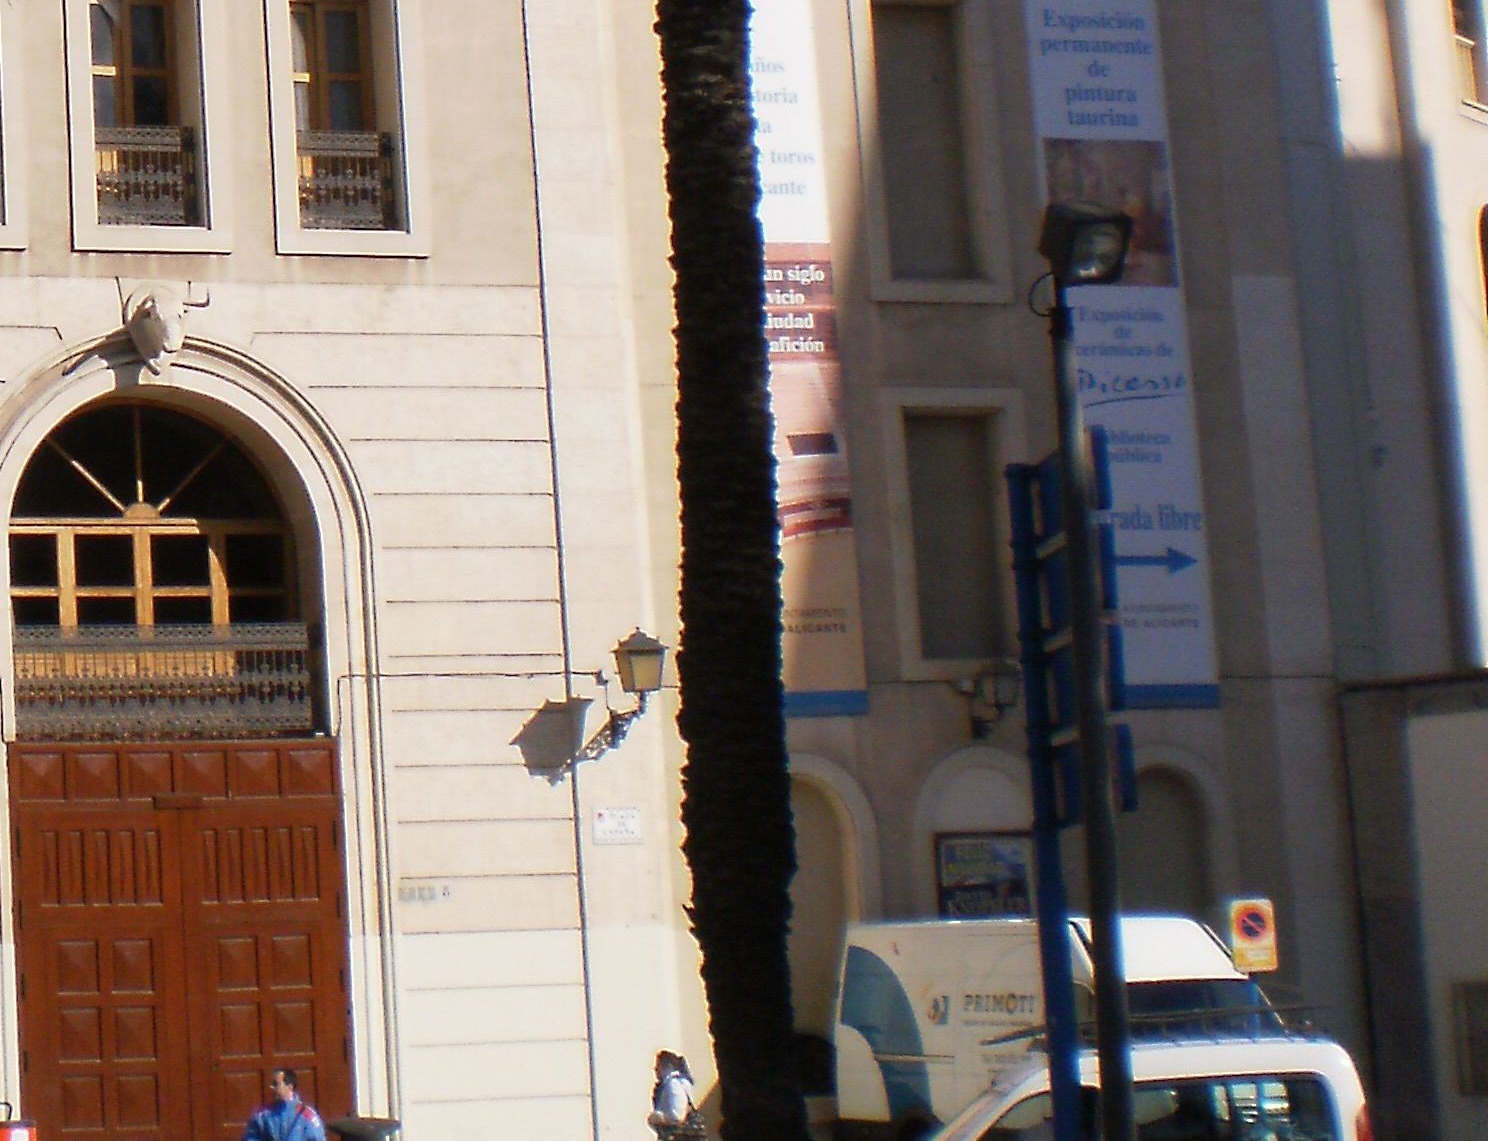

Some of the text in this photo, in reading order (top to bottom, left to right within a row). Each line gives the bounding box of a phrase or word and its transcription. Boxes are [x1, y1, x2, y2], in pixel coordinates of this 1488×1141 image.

[1039, 38, 1153, 56] permanente
[1087, 60, 1111, 77] de
[754, 88, 799, 105] toria
[1065, 84, 1138, 105] pintura
[1067, 108, 1139, 128] taurina
[787, 263, 826, 286] siglo
[765, 289, 806, 305] vicio
[765, 313, 815, 329] iudad
[1157, 504, 1201, 530] libre
